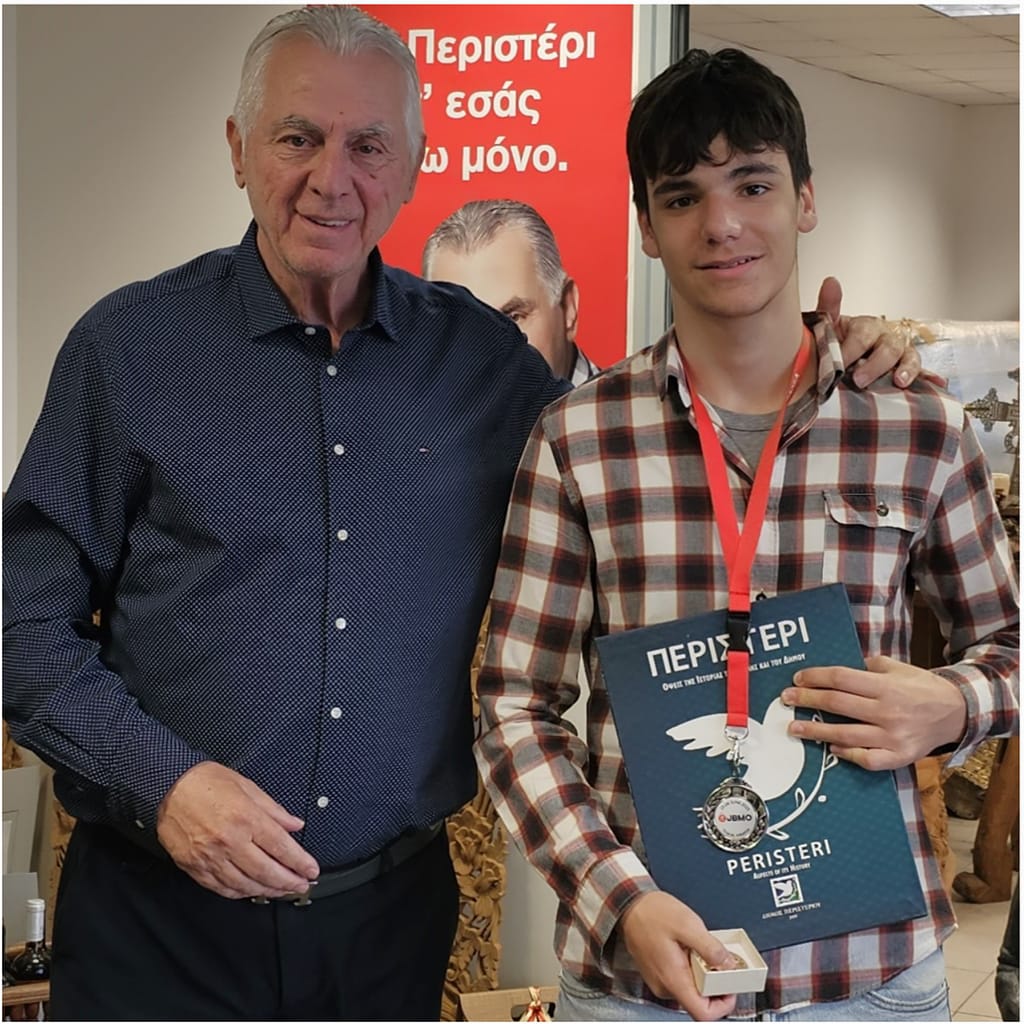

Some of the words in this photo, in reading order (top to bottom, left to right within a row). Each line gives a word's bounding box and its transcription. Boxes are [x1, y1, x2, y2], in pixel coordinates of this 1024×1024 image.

[408, 23, 595, 71] Περιστέρι
[445, 80, 542, 125] εσάς
[462, 136, 568, 181] μόνο.
[726, 839, 832, 876] PERISTERI
